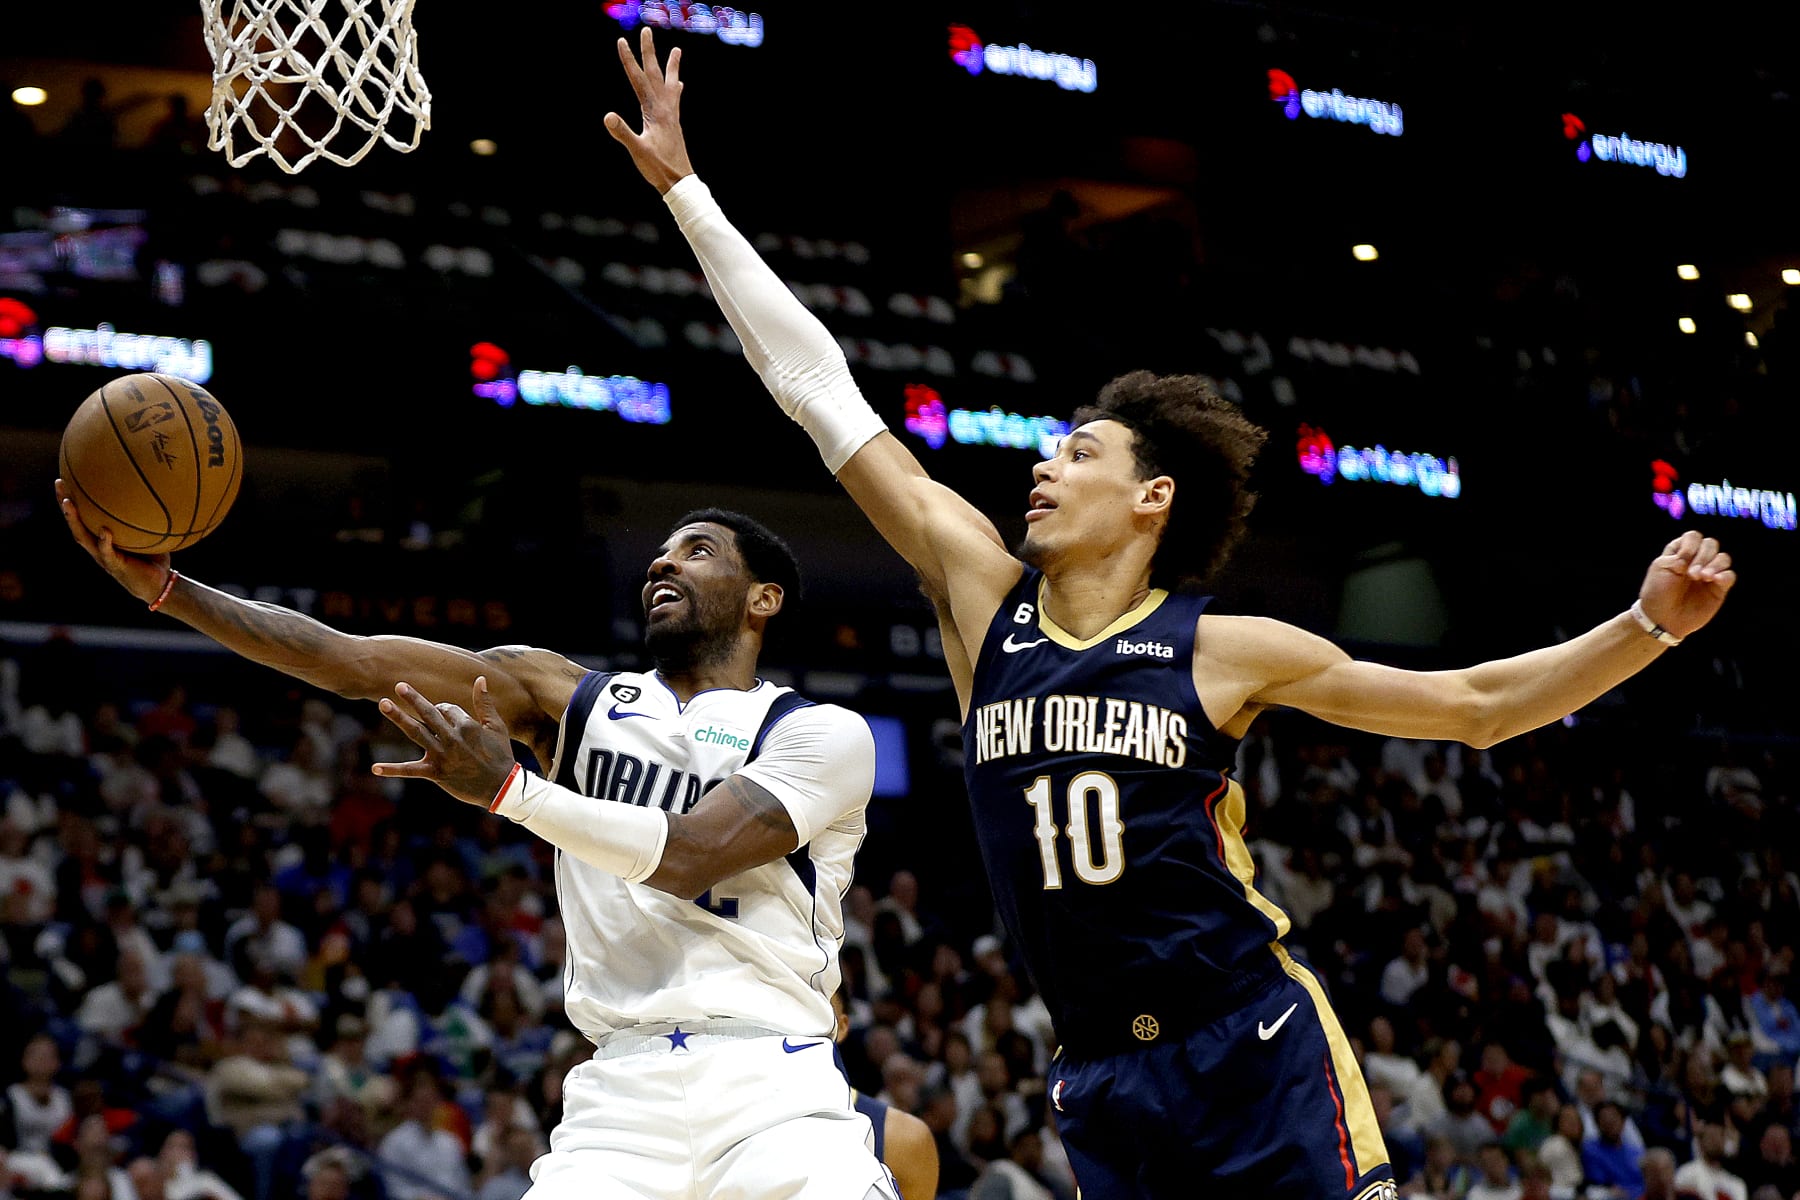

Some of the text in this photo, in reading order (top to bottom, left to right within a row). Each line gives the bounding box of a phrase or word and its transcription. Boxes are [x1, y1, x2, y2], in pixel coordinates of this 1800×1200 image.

[984, 43, 1097, 93] entergy
[1301, 88, 1403, 136] entergy
[1592, 132, 1687, 178] entergy
[1687, 478, 1797, 530] entergy
[1013, 602, 1034, 624] 6
[1116, 639, 1174, 658] ibotta
[613, 687, 637, 702] 6
[694, 726, 749, 750] chime
[976, 695, 1187, 769] NEW ORLEANS
[1023, 770, 1125, 889] 10
